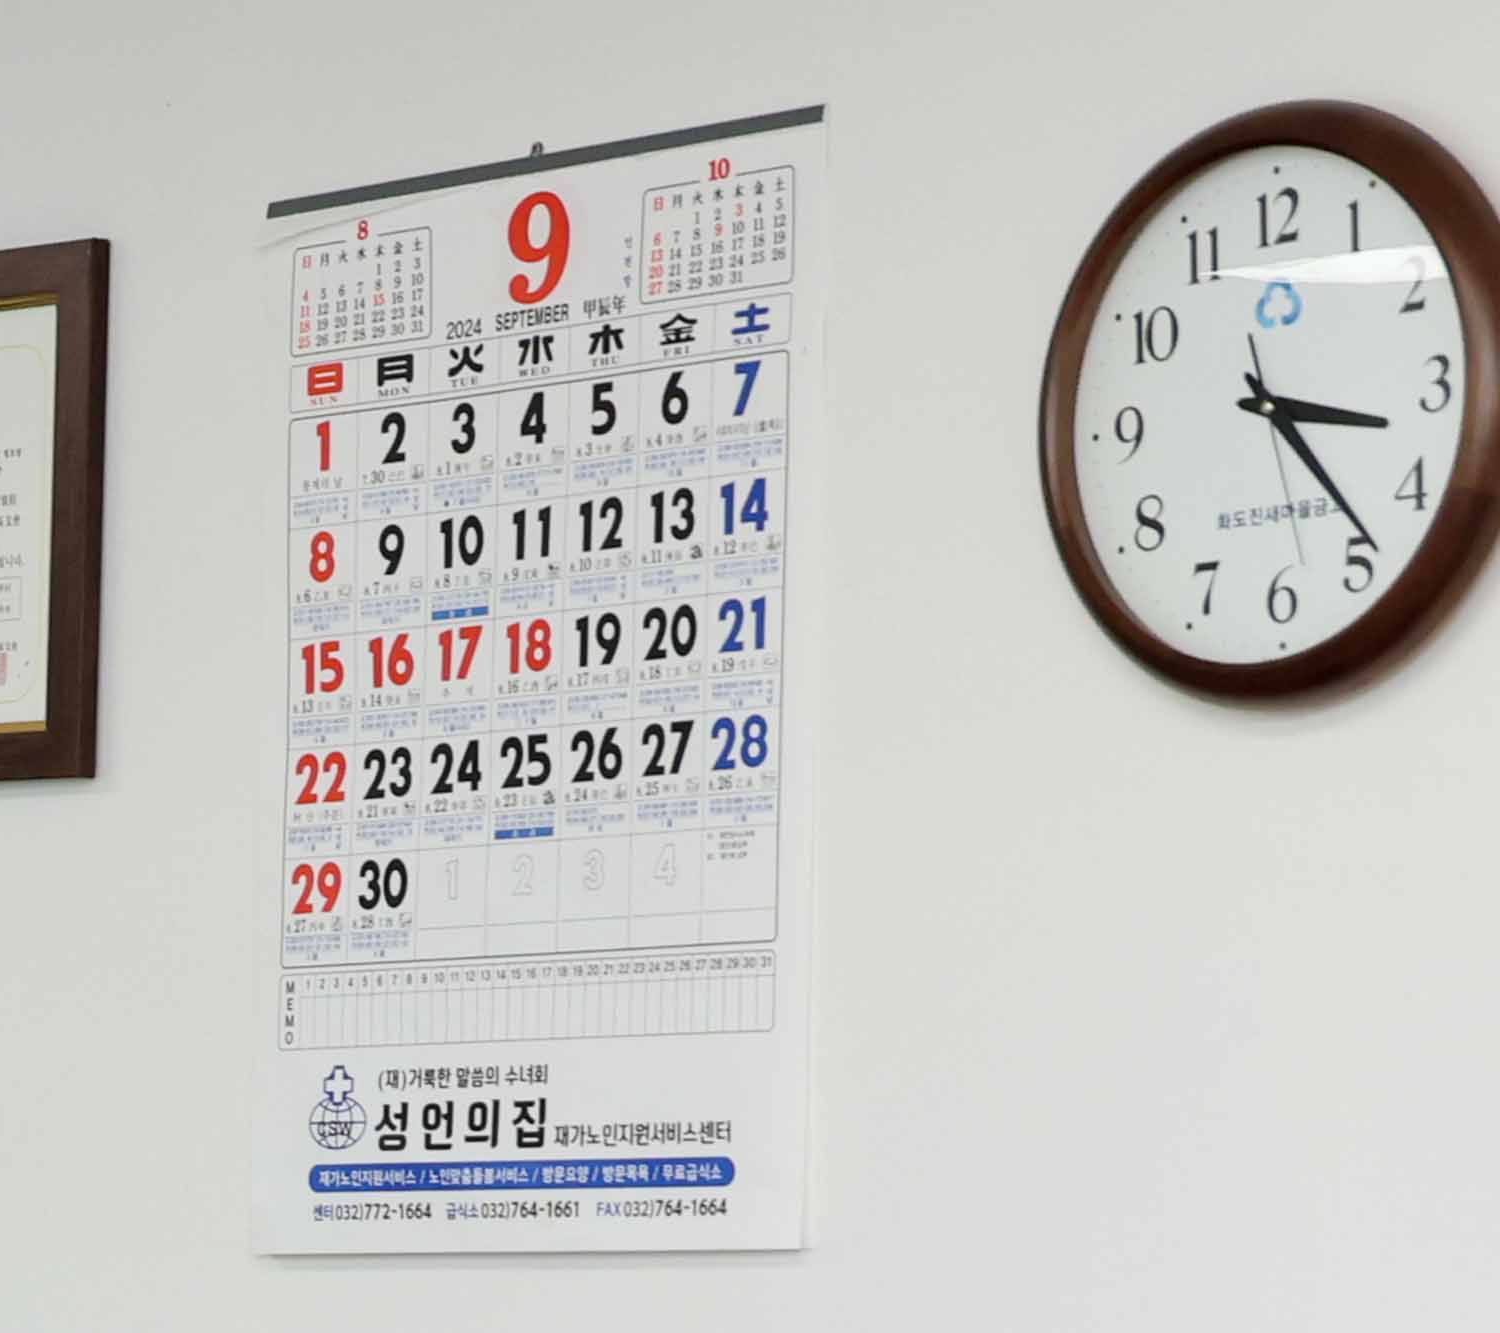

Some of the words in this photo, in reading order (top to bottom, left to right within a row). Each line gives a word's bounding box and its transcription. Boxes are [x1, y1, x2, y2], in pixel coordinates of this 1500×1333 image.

[709, 158, 730, 181] 10
[357, 220, 368, 240] 8
[1257, 187, 1298, 248] 12
[1348, 200, 1361, 252] 1
[508, 191, 570, 304] 9
[1186, 225, 1222, 286] 11
[307, 362, 343, 396] 日
[377, 354, 414, 387] 月
[448, 344, 484, 377] 火
[518, 335, 554, 366] 水
[588, 324, 624, 355] 木
[659, 313, 697, 346] 金
[732, 303, 770, 335] 土
[446, 318, 482, 340] 2024
[495, 304, 570, 332] SEPTEMBER
[1134, 306, 1178, 364] 10
[377, 387, 411, 398] MON
[450, 377, 480, 388] TUE
[518, 366, 551, 377] WED
[591, 355, 619, 368] THU
[664, 346, 691, 357] FRI
[734, 335, 763, 345] SAT
[1420, 355, 1451, 412] 3
[316, 421, 330, 471] 1
[381, 412, 406, 464] 2
[451, 403, 475, 454] 3
[520, 392, 546, 444] 4
[591, 382, 616, 435] 5
[662, 371, 688, 425] 6
[733, 360, 761, 416] 7
[1114, 406, 1145, 465] 9
[1395, 457, 1427, 510] 4
[310, 531, 335, 583] 8
[379, 524, 404, 575] 9
[440, 515, 484, 569] 10
[513, 506, 551, 560] 11
[579, 496, 623, 552] 12
[651, 488, 695, 543] 13
[721, 478, 768, 535] 14
[1135, 495, 1164, 551] 8
[1194, 561, 1220, 615] 7
[1342, 536, 1375, 593] 5
[1266, 564, 1299, 624] 6
[302, 641, 344, 694] 15
[369, 634, 414, 688] 16
[439, 625, 483, 681] 17
[507, 619, 551, 674] 18
[576, 612, 621, 667] 19
[643, 604, 697, 661] 20
[719, 596, 766, 653] 21
[295, 752, 346, 805] 22
[364, 747, 412, 800] 23
[430, 740, 482, 794] 24
[500, 733, 551, 789] 25
[571, 727, 622, 783] 26
[642, 720, 694, 777] 27
[711, 715, 767, 771] 28
[292, 862, 341, 914] 29
[358, 858, 408, 910] 30
[378, 1066, 450, 1091] (재)거룩한
[456, 1066, 500, 1088] 말씀의
[505, 1064, 548, 1085] 수녀회
[554, 1120, 732, 1147] 재가노인지원서비스센터
[596, 1202, 621, 1217] FAX
